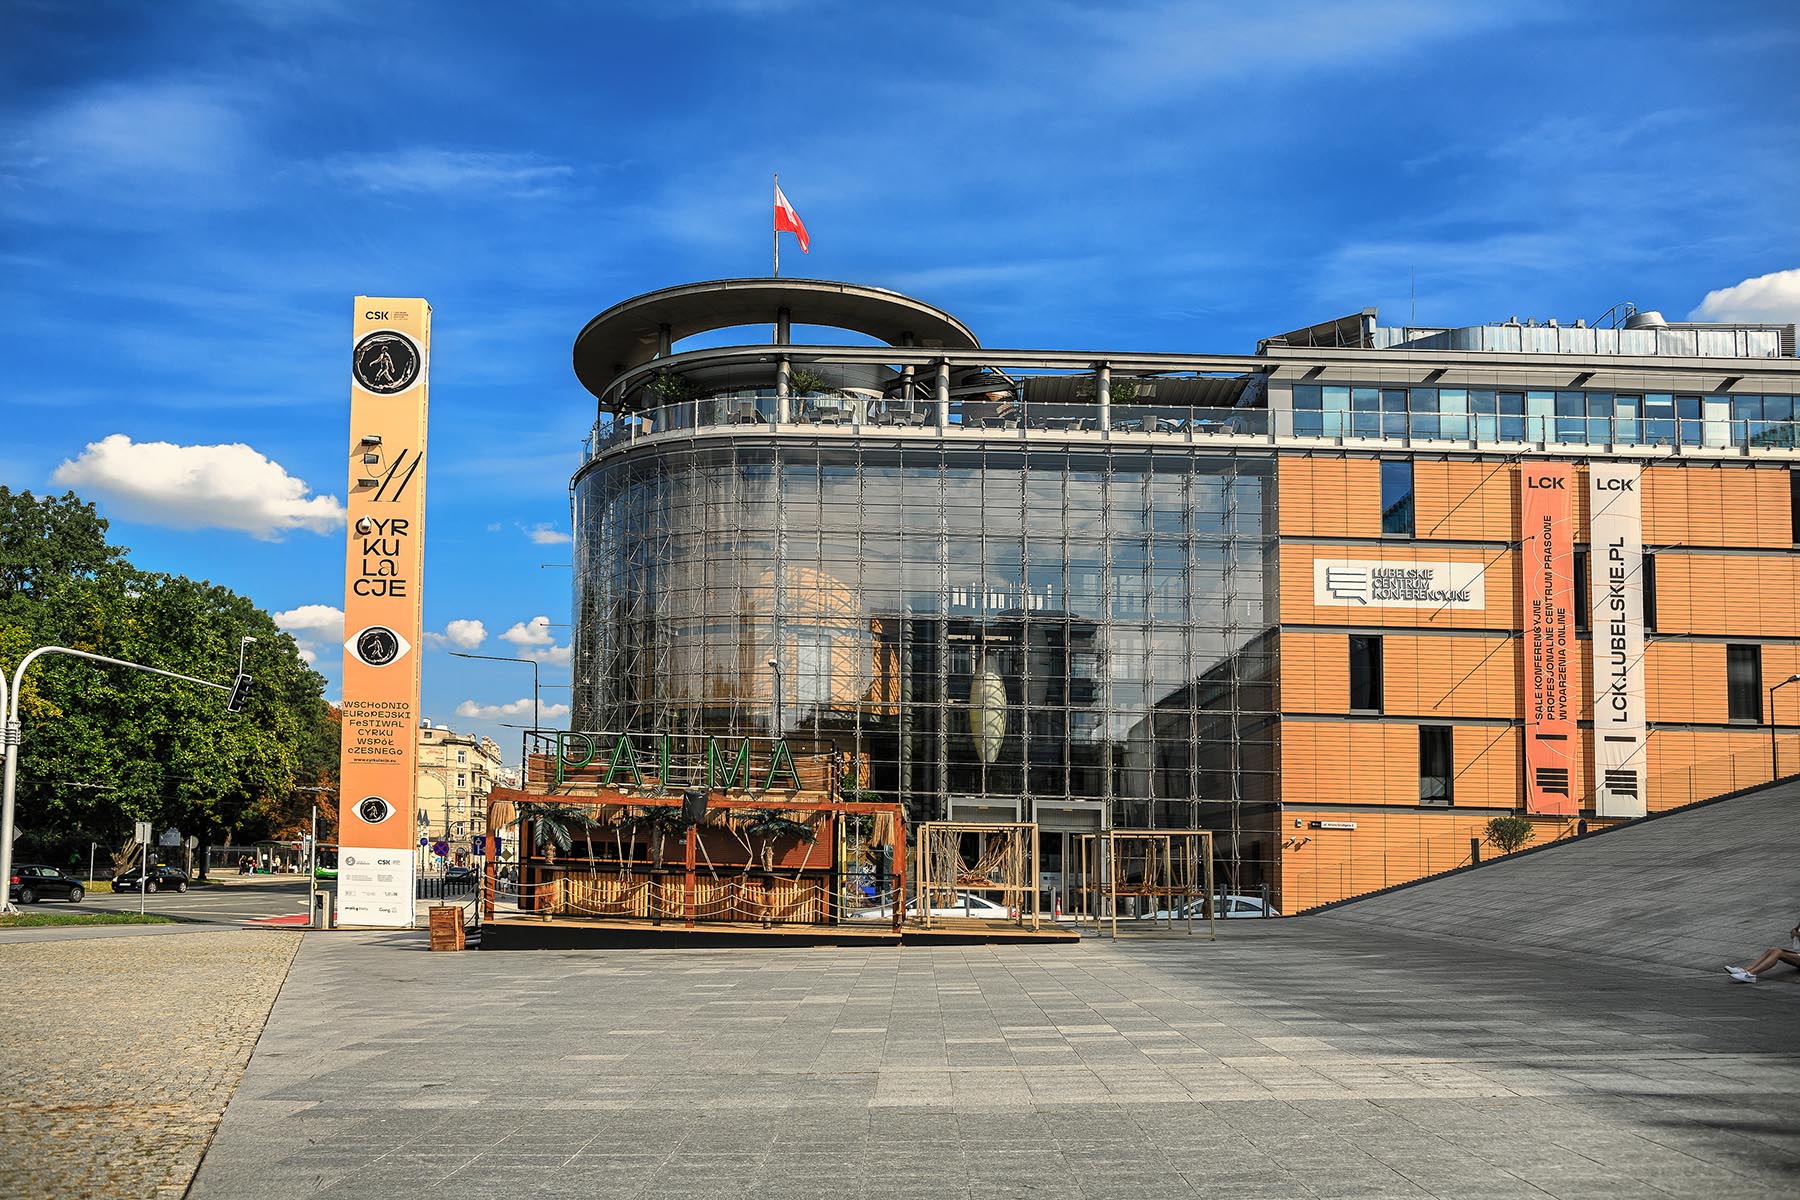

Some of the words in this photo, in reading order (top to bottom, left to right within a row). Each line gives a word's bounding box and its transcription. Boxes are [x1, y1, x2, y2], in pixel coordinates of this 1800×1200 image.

[365, 311, 389, 320] CSK
[1528, 477, 1565, 490] LCK
[1597, 478, 1633, 492] LCK
[355, 518, 409, 536] CYR
[363, 539, 399, 556] KU
[1543, 515, 1552, 569] PRASOWE
[1372, 568, 1434, 580] LUBELSKIE
[353, 579, 407, 597] CJE
[1372, 578, 1430, 590] CENTRUM
[1372, 588, 1471, 602] KONFERENCYJNE
[1544, 572, 1553, 624] CENTRUM
[1557, 608, 1566, 646] ONLINE
[1609, 536, 1628, 723] LCK.LUBELSKIE.PL
[1533, 600, 1542, 690] KONFERENCYJNE
[1546, 627, 1555, 720] PROFESJONALNE
[1559, 649, 1567, 720] WYDARZENIA
[1535, 693, 1543, 720] SALE
[357, 729, 393, 737] CYRKU
[556, 732, 801, 791] PALMA
